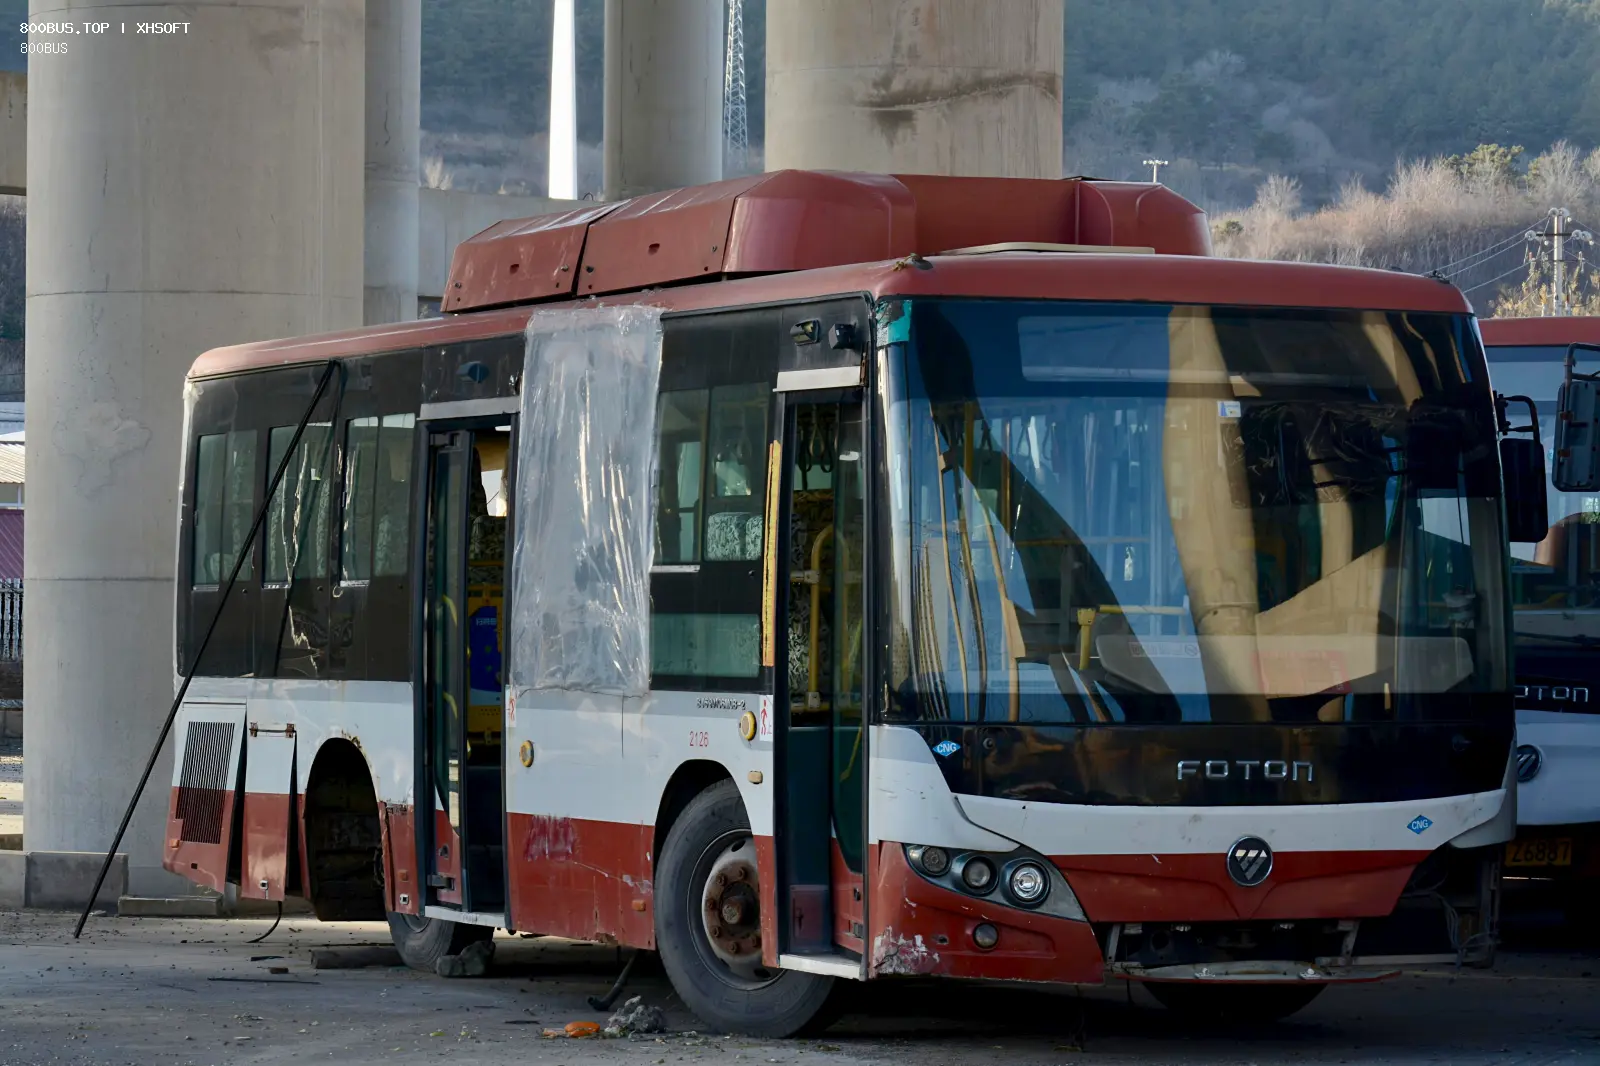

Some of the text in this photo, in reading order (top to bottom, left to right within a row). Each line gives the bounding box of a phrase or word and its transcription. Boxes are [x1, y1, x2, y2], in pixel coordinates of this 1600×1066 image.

[1514, 684, 1589, 703] OTON
[937, 742, 957, 753] CNG
[1177, 760, 1313, 782] FOTON
[1411, 819, 1429, 830] CNG
